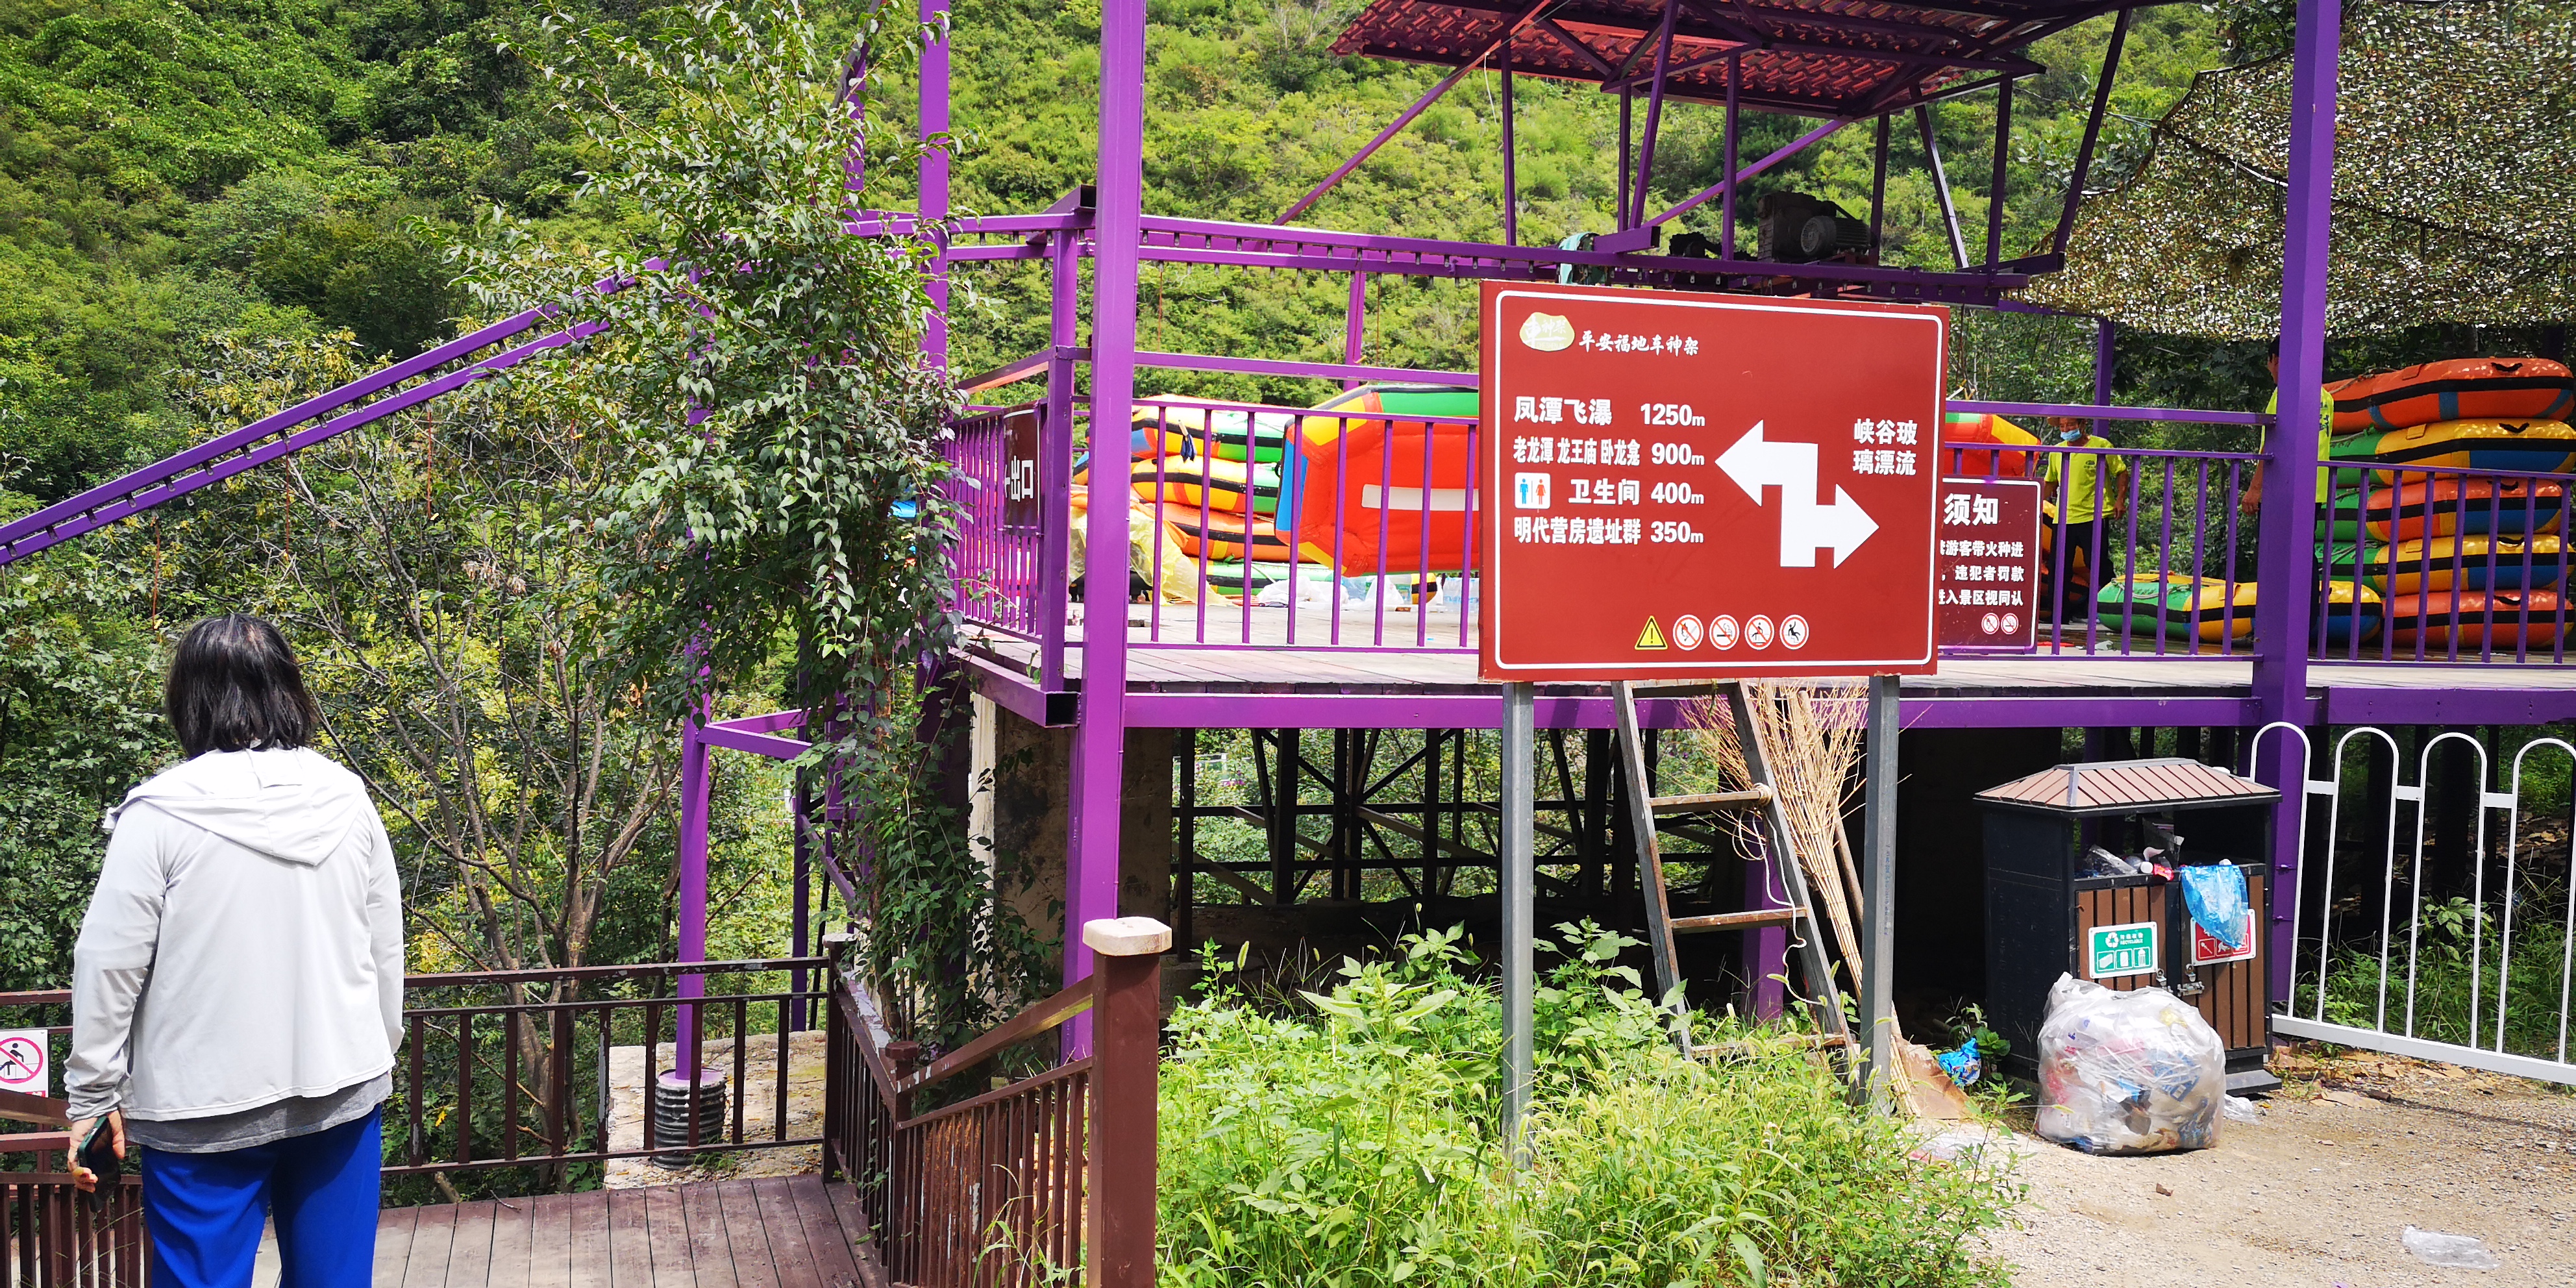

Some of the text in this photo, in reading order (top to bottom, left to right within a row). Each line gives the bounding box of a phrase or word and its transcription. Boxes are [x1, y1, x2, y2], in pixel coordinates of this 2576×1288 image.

[1514, 396, 1705, 427] 凤潭飞瀑 1250m
[1853, 417, 1918, 445] 峡谷玻
[1513, 435, 1705, 466] 老龙潭 龙王庙 卧龙龛 900m
[1852, 449, 1916, 476] 璃漂流
[1011, 455, 1034, 502] 出口
[1568, 478, 1704, 506] 卫生间 400m
[1944, 493, 1999, 526] 须知
[1514, 516, 1704, 545] 明代营房遗址群 350m
